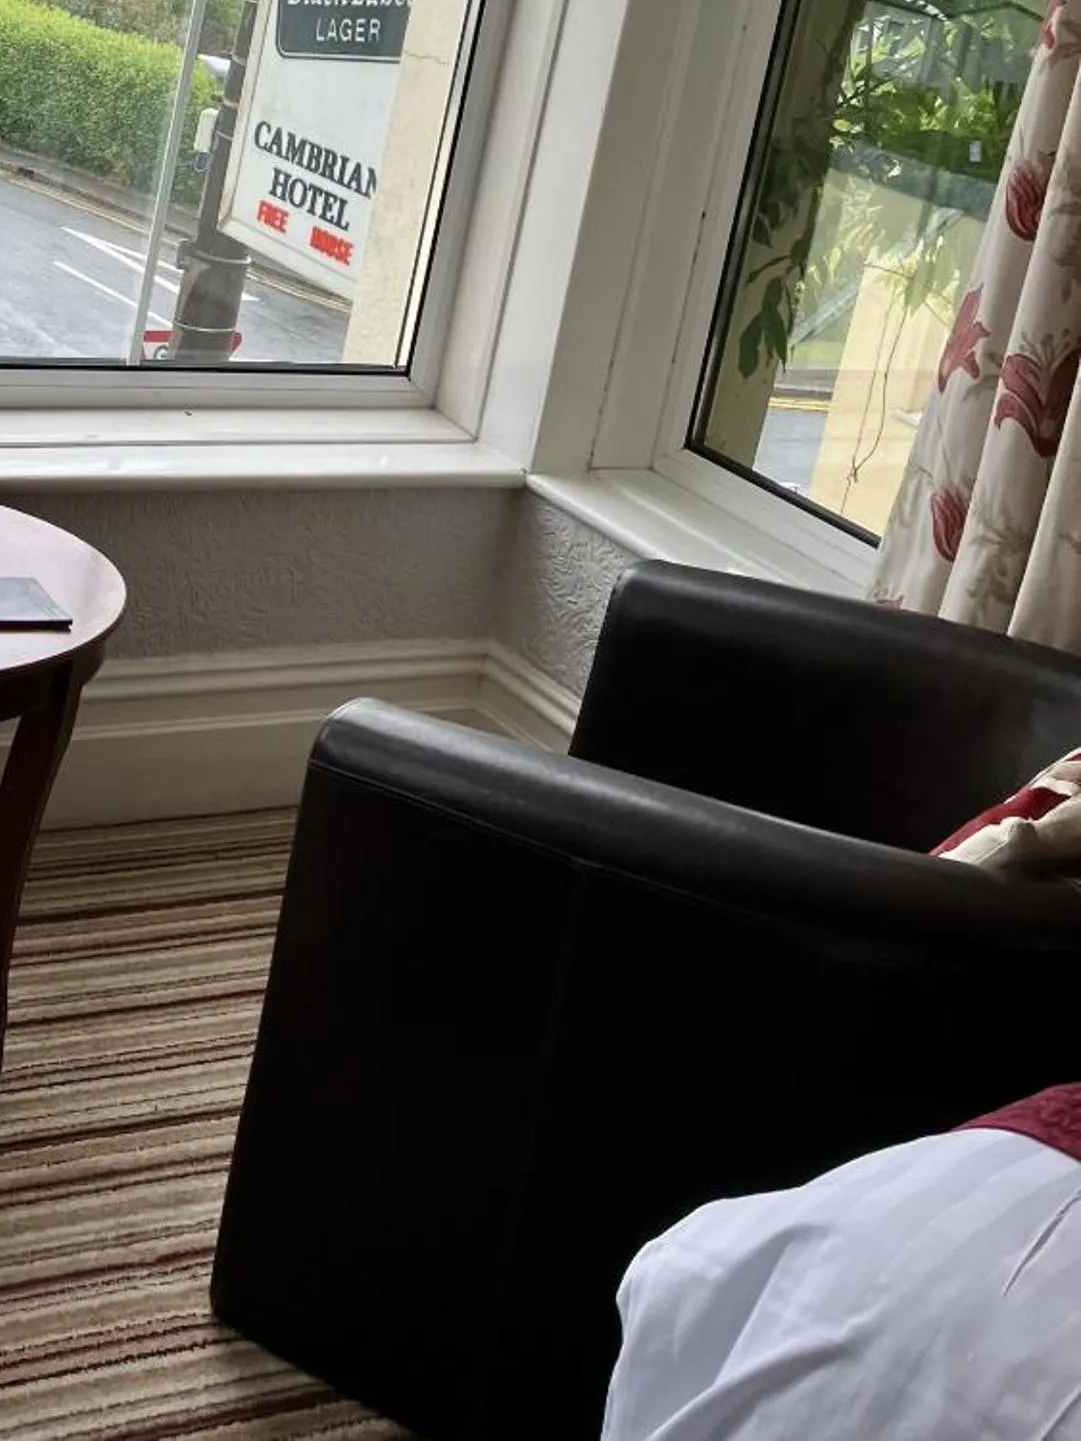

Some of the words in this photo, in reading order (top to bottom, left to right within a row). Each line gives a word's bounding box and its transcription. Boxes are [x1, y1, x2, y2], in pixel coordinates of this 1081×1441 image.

[315, 18, 381, 42] LAGER
[254, 120, 377, 200] CAMBRIAN
[257, 200, 289, 234] FREE
[269, 167, 350, 232] HOTEL
